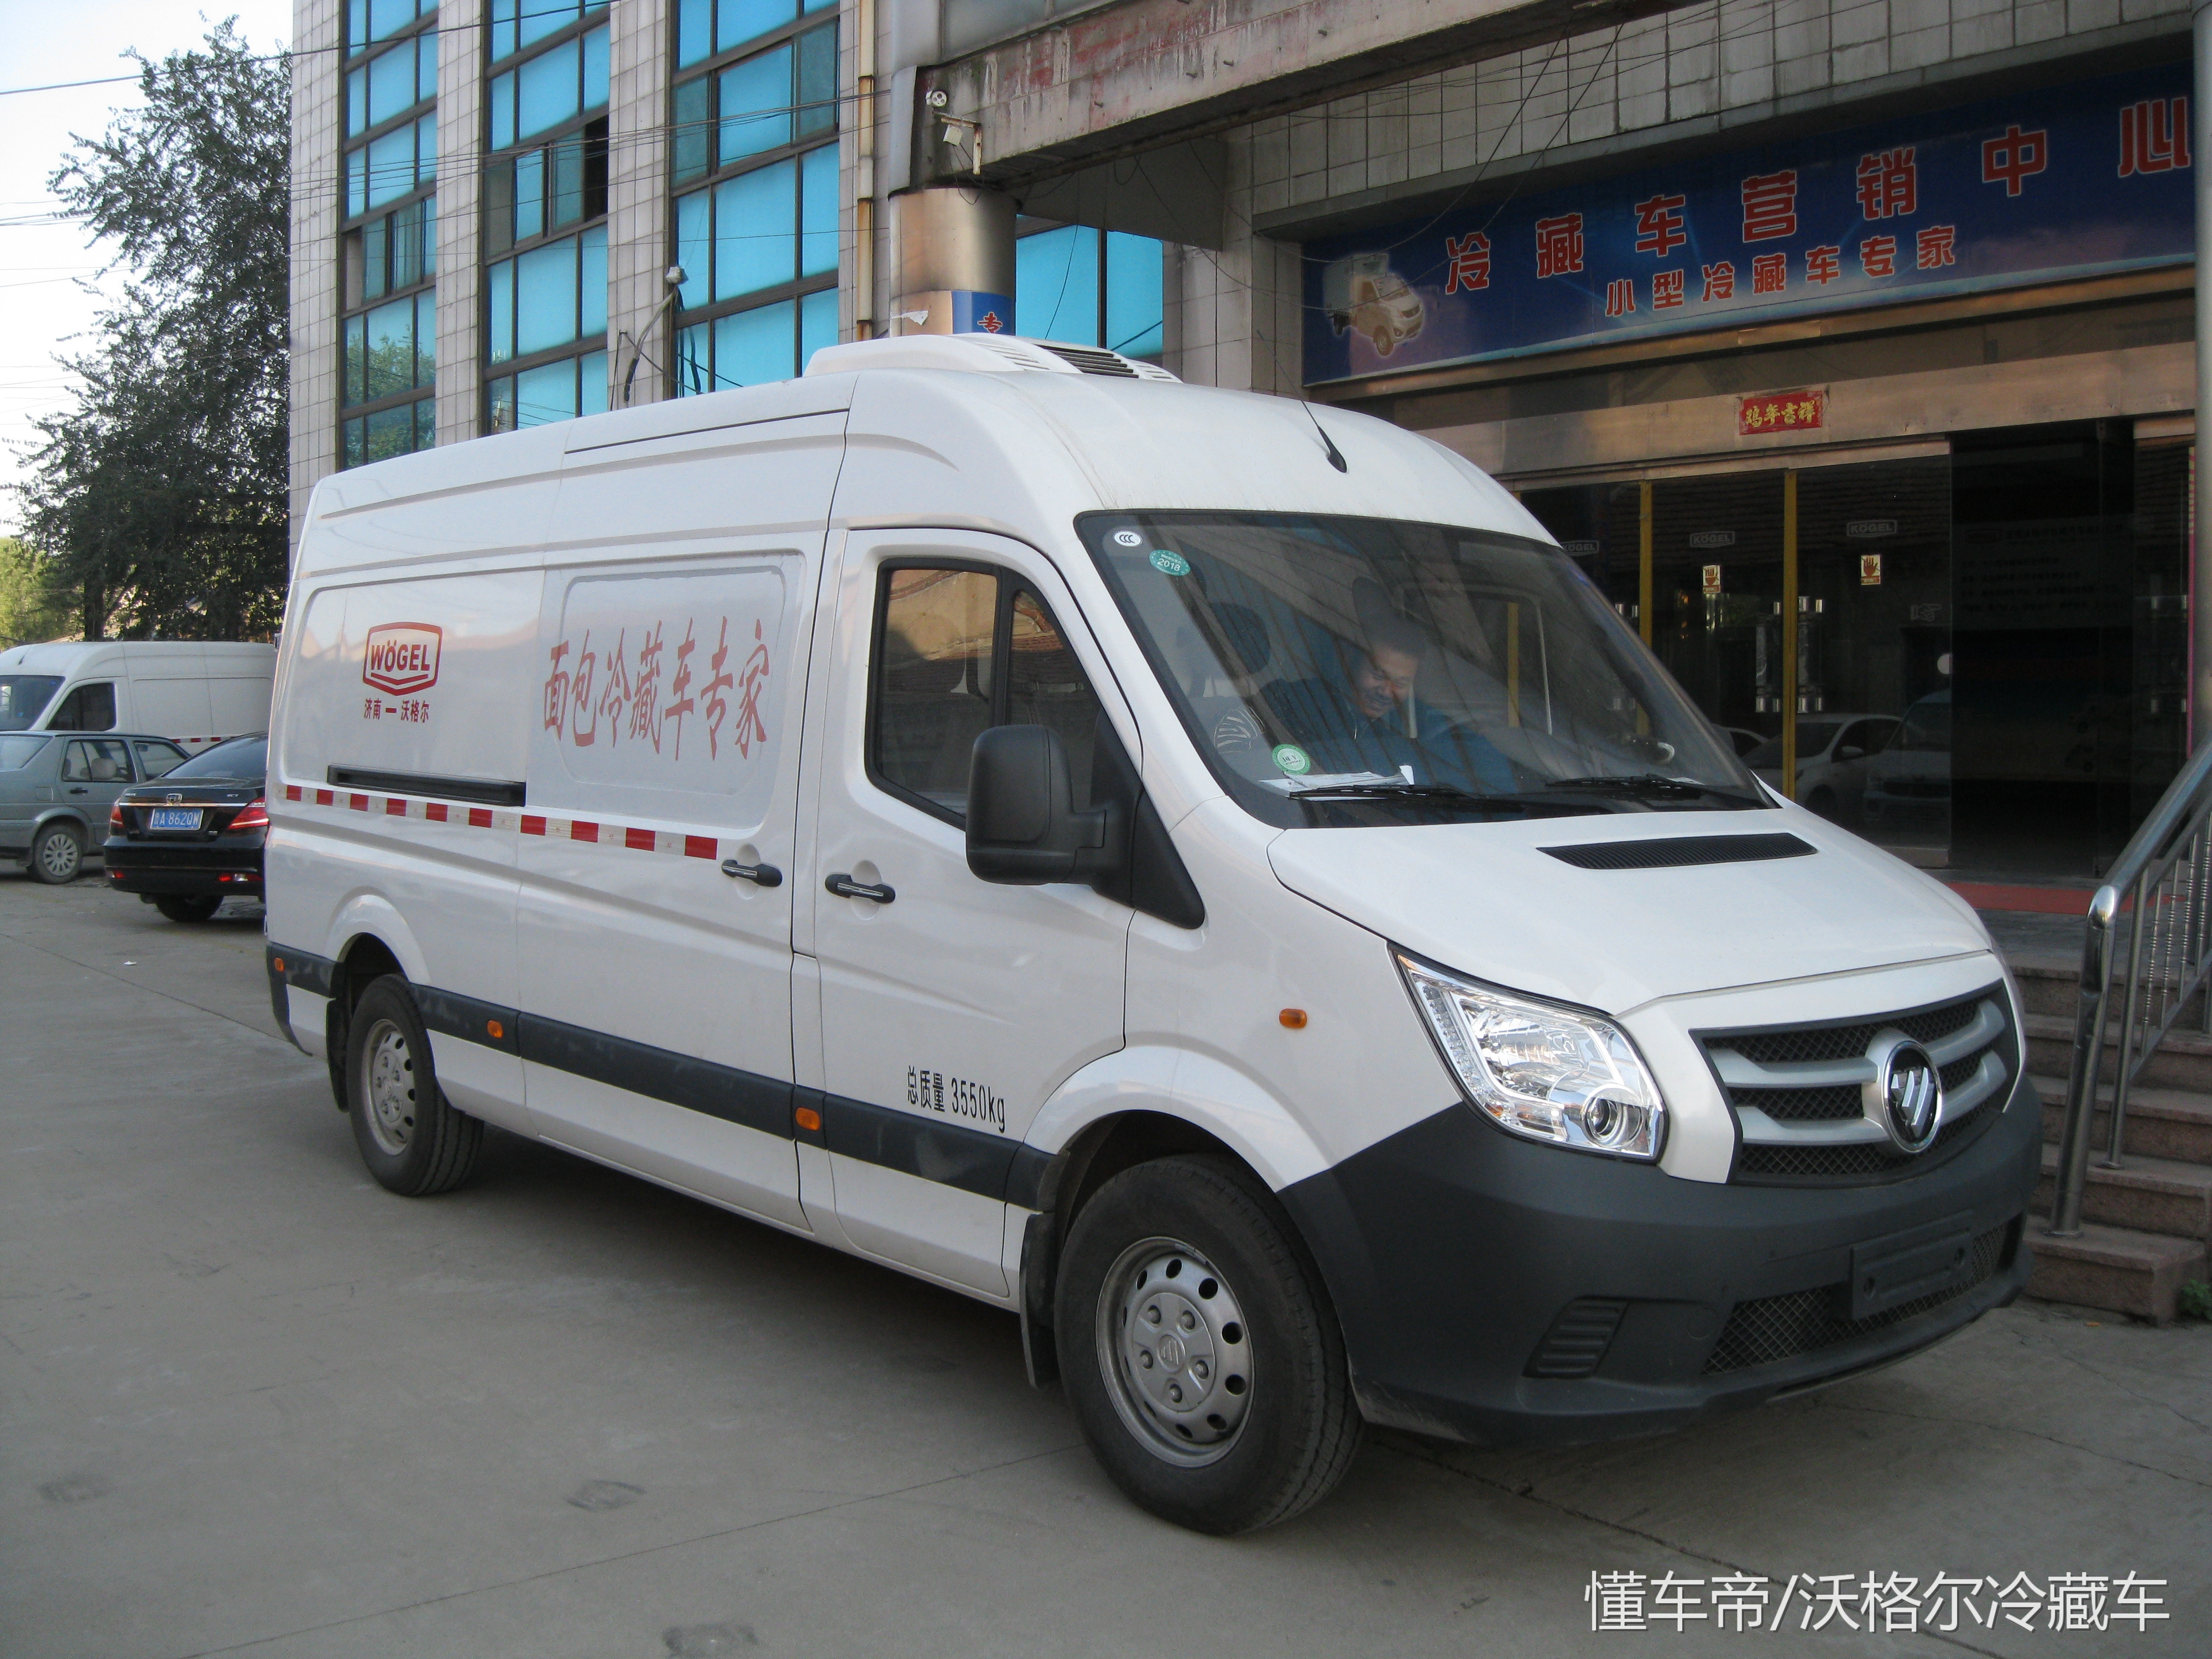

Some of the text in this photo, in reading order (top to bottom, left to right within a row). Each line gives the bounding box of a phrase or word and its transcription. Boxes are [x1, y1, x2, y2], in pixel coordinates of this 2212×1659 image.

[1445, 96, 2191, 295] 冷藏车营销中心
[1606, 225, 1955, 317] 小型冷藏车专家
[1746, 399, 1815, 428] 鸡年吉祥
[1157, 558, 1181, 572] 2018
[371, 640, 430, 672] WÖGEL
[544, 615, 770, 761] 面包冷藏车专家
[907, 1065, 1005, 1134] 总质量 3550kg
